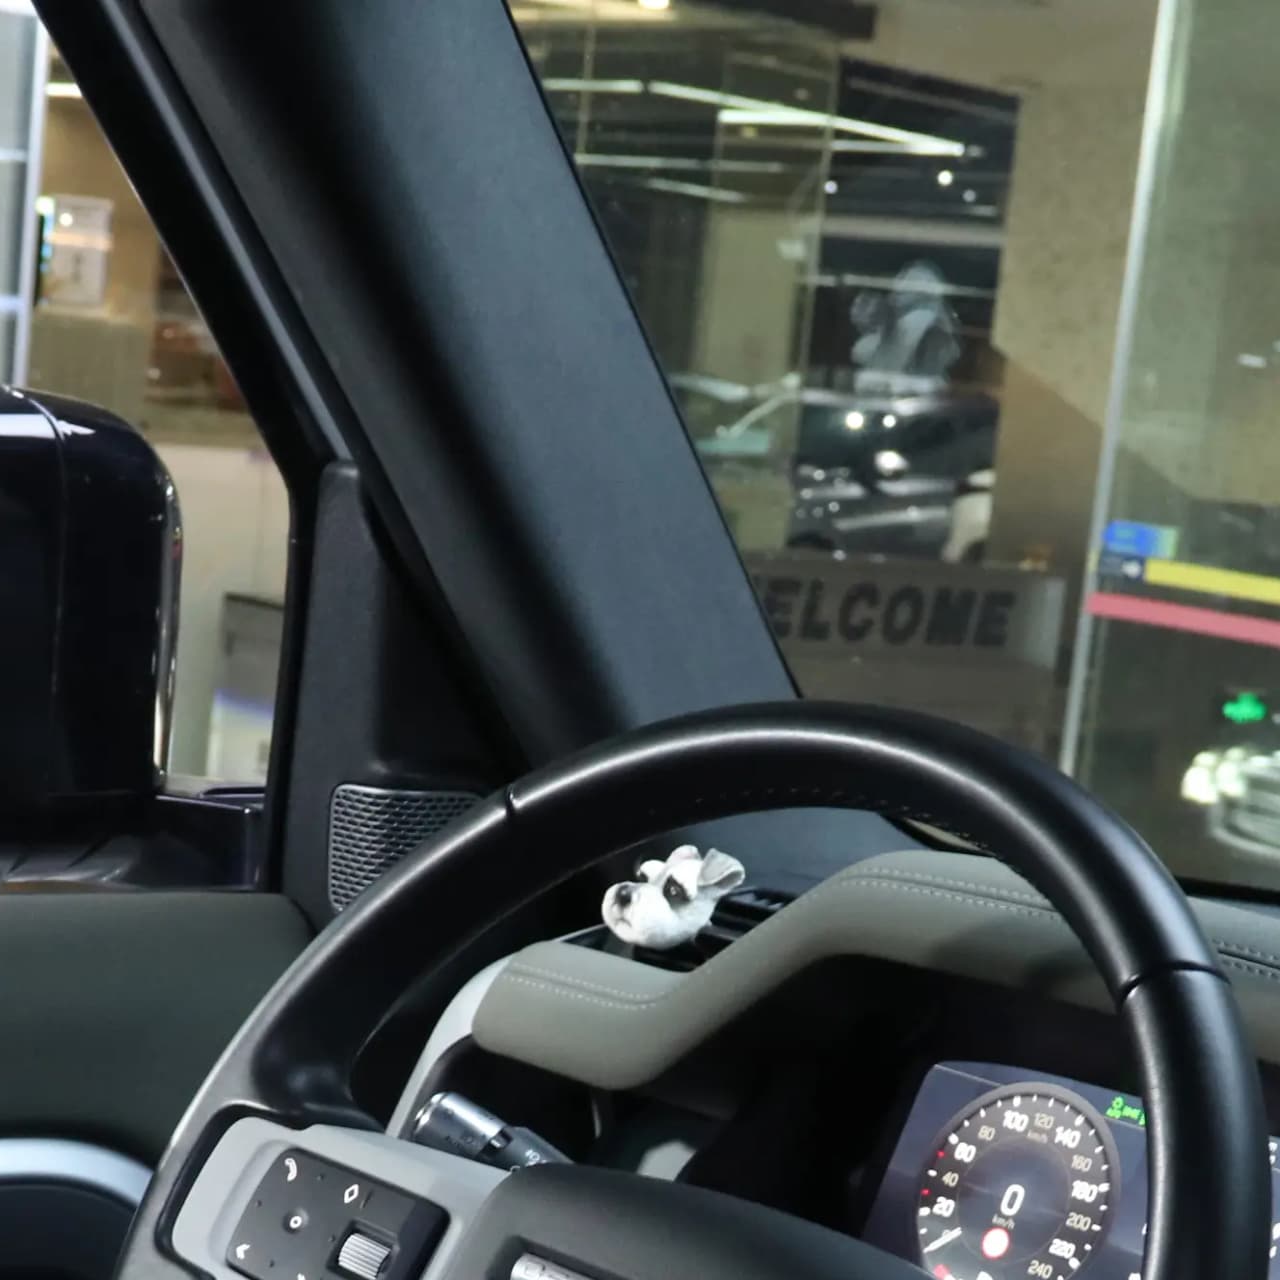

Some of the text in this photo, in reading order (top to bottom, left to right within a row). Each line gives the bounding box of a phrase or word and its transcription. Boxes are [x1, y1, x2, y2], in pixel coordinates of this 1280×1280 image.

[754, 576, 1016, 648] ELCOME
[1003, 1110, 1029, 1132] 100
[1034, 1113, 1055, 1130] 120
[1055, 1126, 1081, 1148] 140
[942, 1172, 959, 1187] 40
[933, 1196, 955, 1217] 20
[1000, 1184, 1025, 1216] 0
[1066, 1212, 1091, 1231] 200
[1049, 1238, 1076, 1259] 220
[1027, 1259, 1053, 1279] 240
